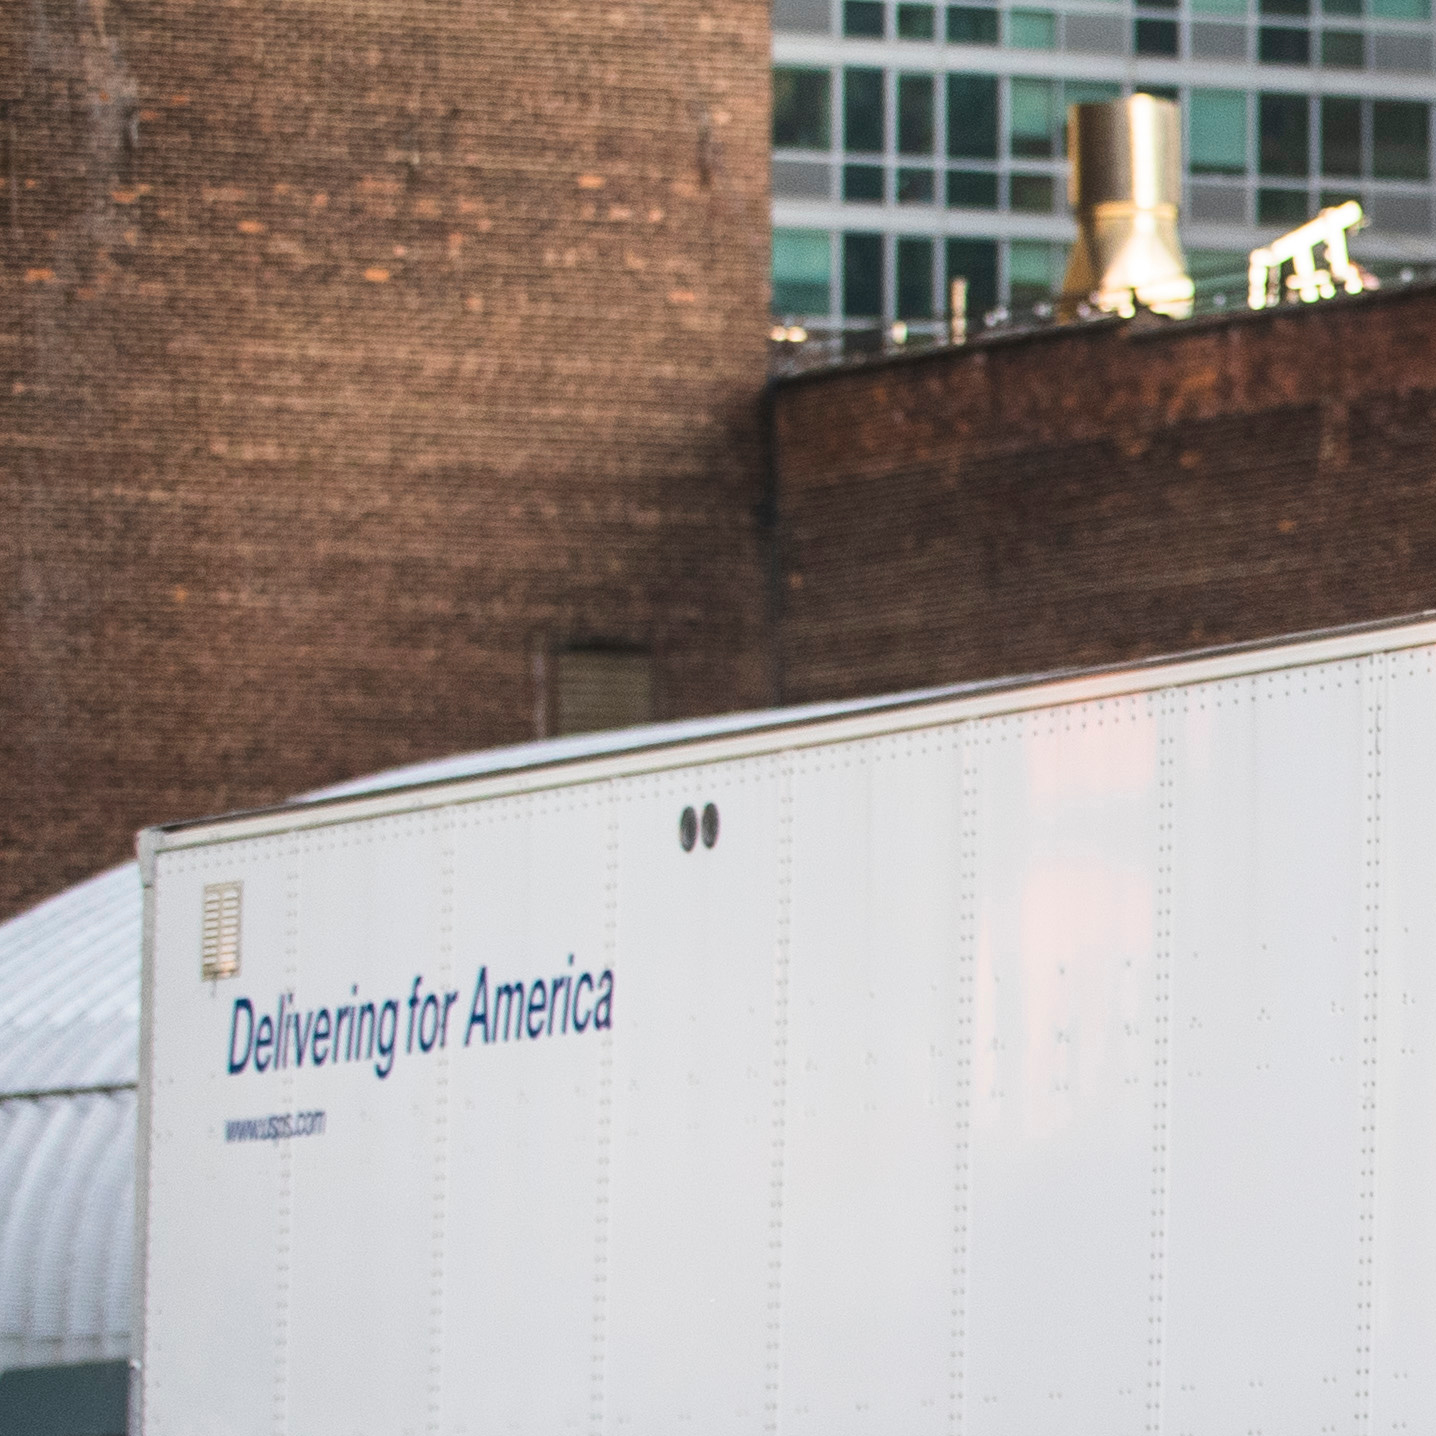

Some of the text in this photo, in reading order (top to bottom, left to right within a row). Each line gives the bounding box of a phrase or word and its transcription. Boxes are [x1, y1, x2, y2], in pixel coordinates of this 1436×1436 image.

[227, 953, 614, 1080] Delivering for America
